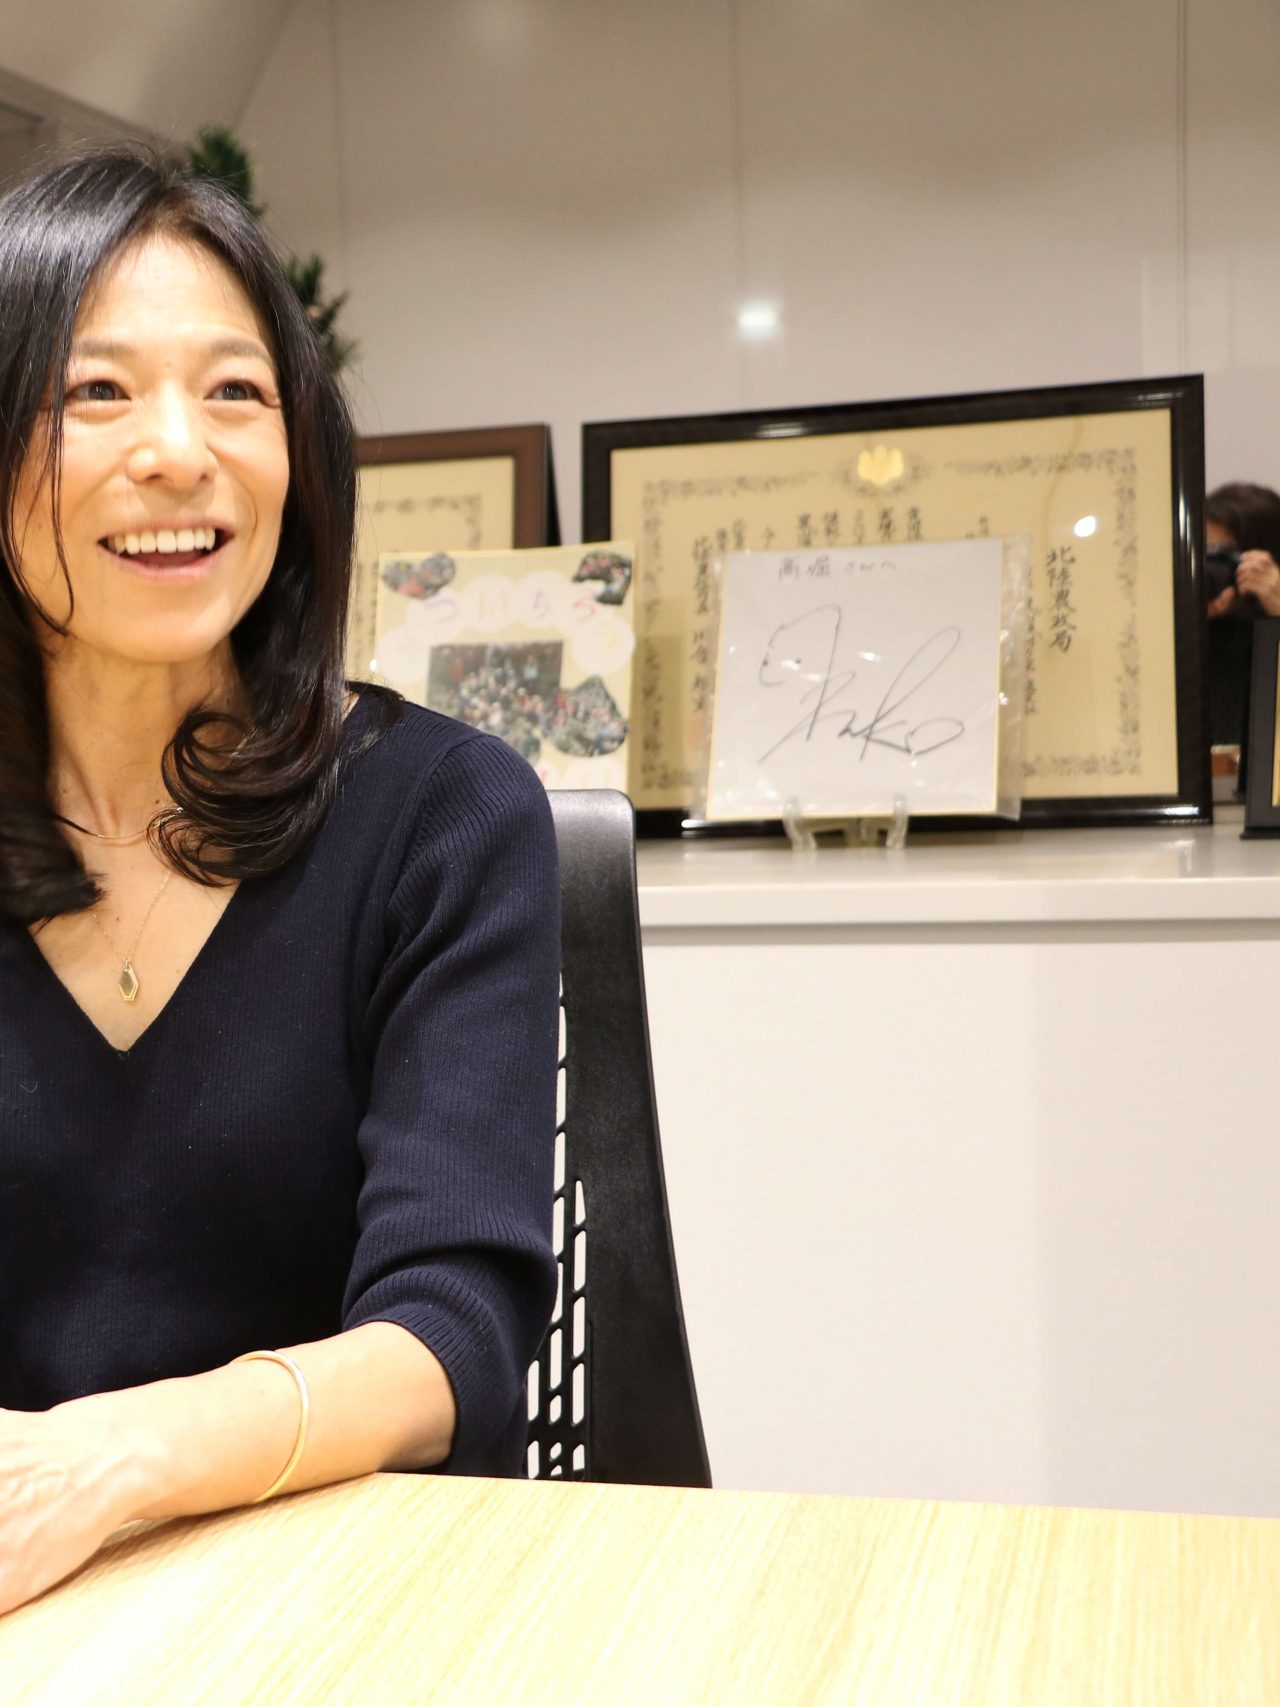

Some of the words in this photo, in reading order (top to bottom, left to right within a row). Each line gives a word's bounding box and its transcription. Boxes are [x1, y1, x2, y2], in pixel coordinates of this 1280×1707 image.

[1045, 546, 1076, 653] 北陸農政局
